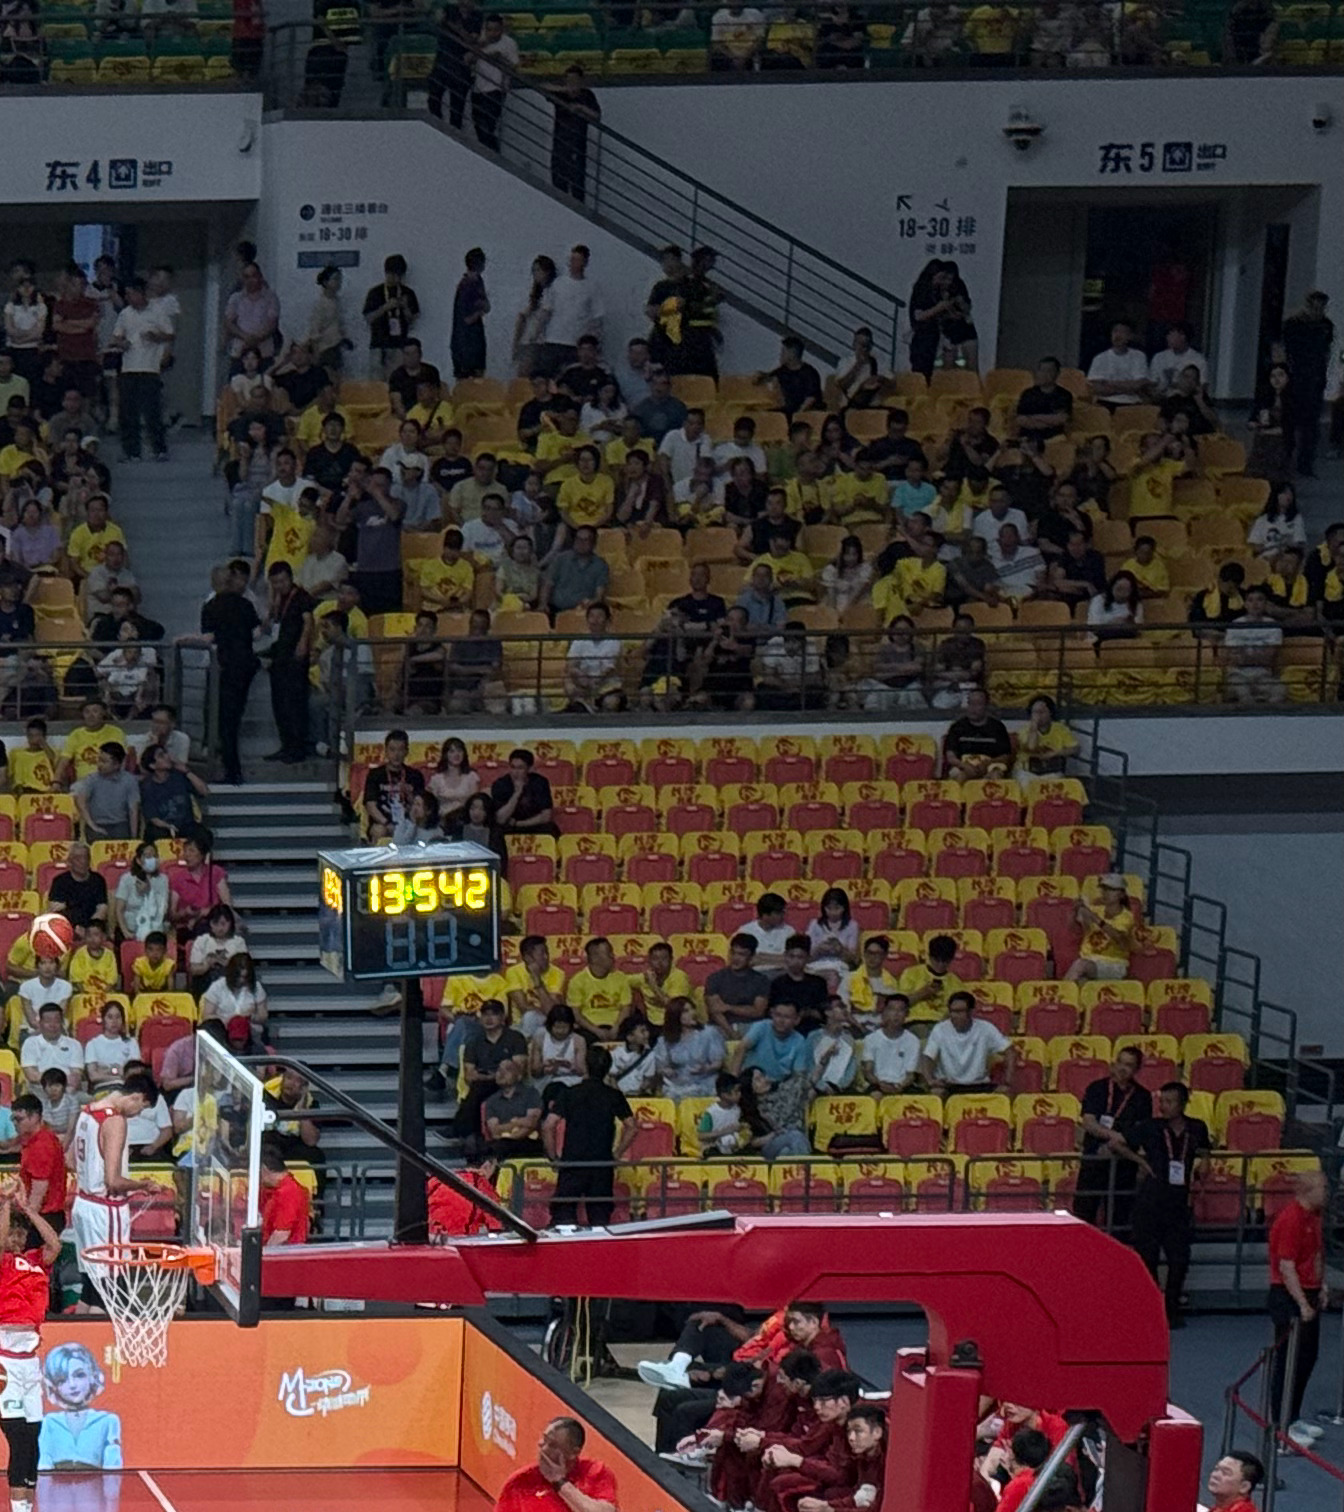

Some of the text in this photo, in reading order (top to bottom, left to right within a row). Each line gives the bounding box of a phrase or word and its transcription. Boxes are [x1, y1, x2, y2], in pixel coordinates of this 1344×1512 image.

[1098, 142, 1155, 174] 东5
[45, 160, 102, 191] 东4
[899, 217, 950, 238] 18-30
